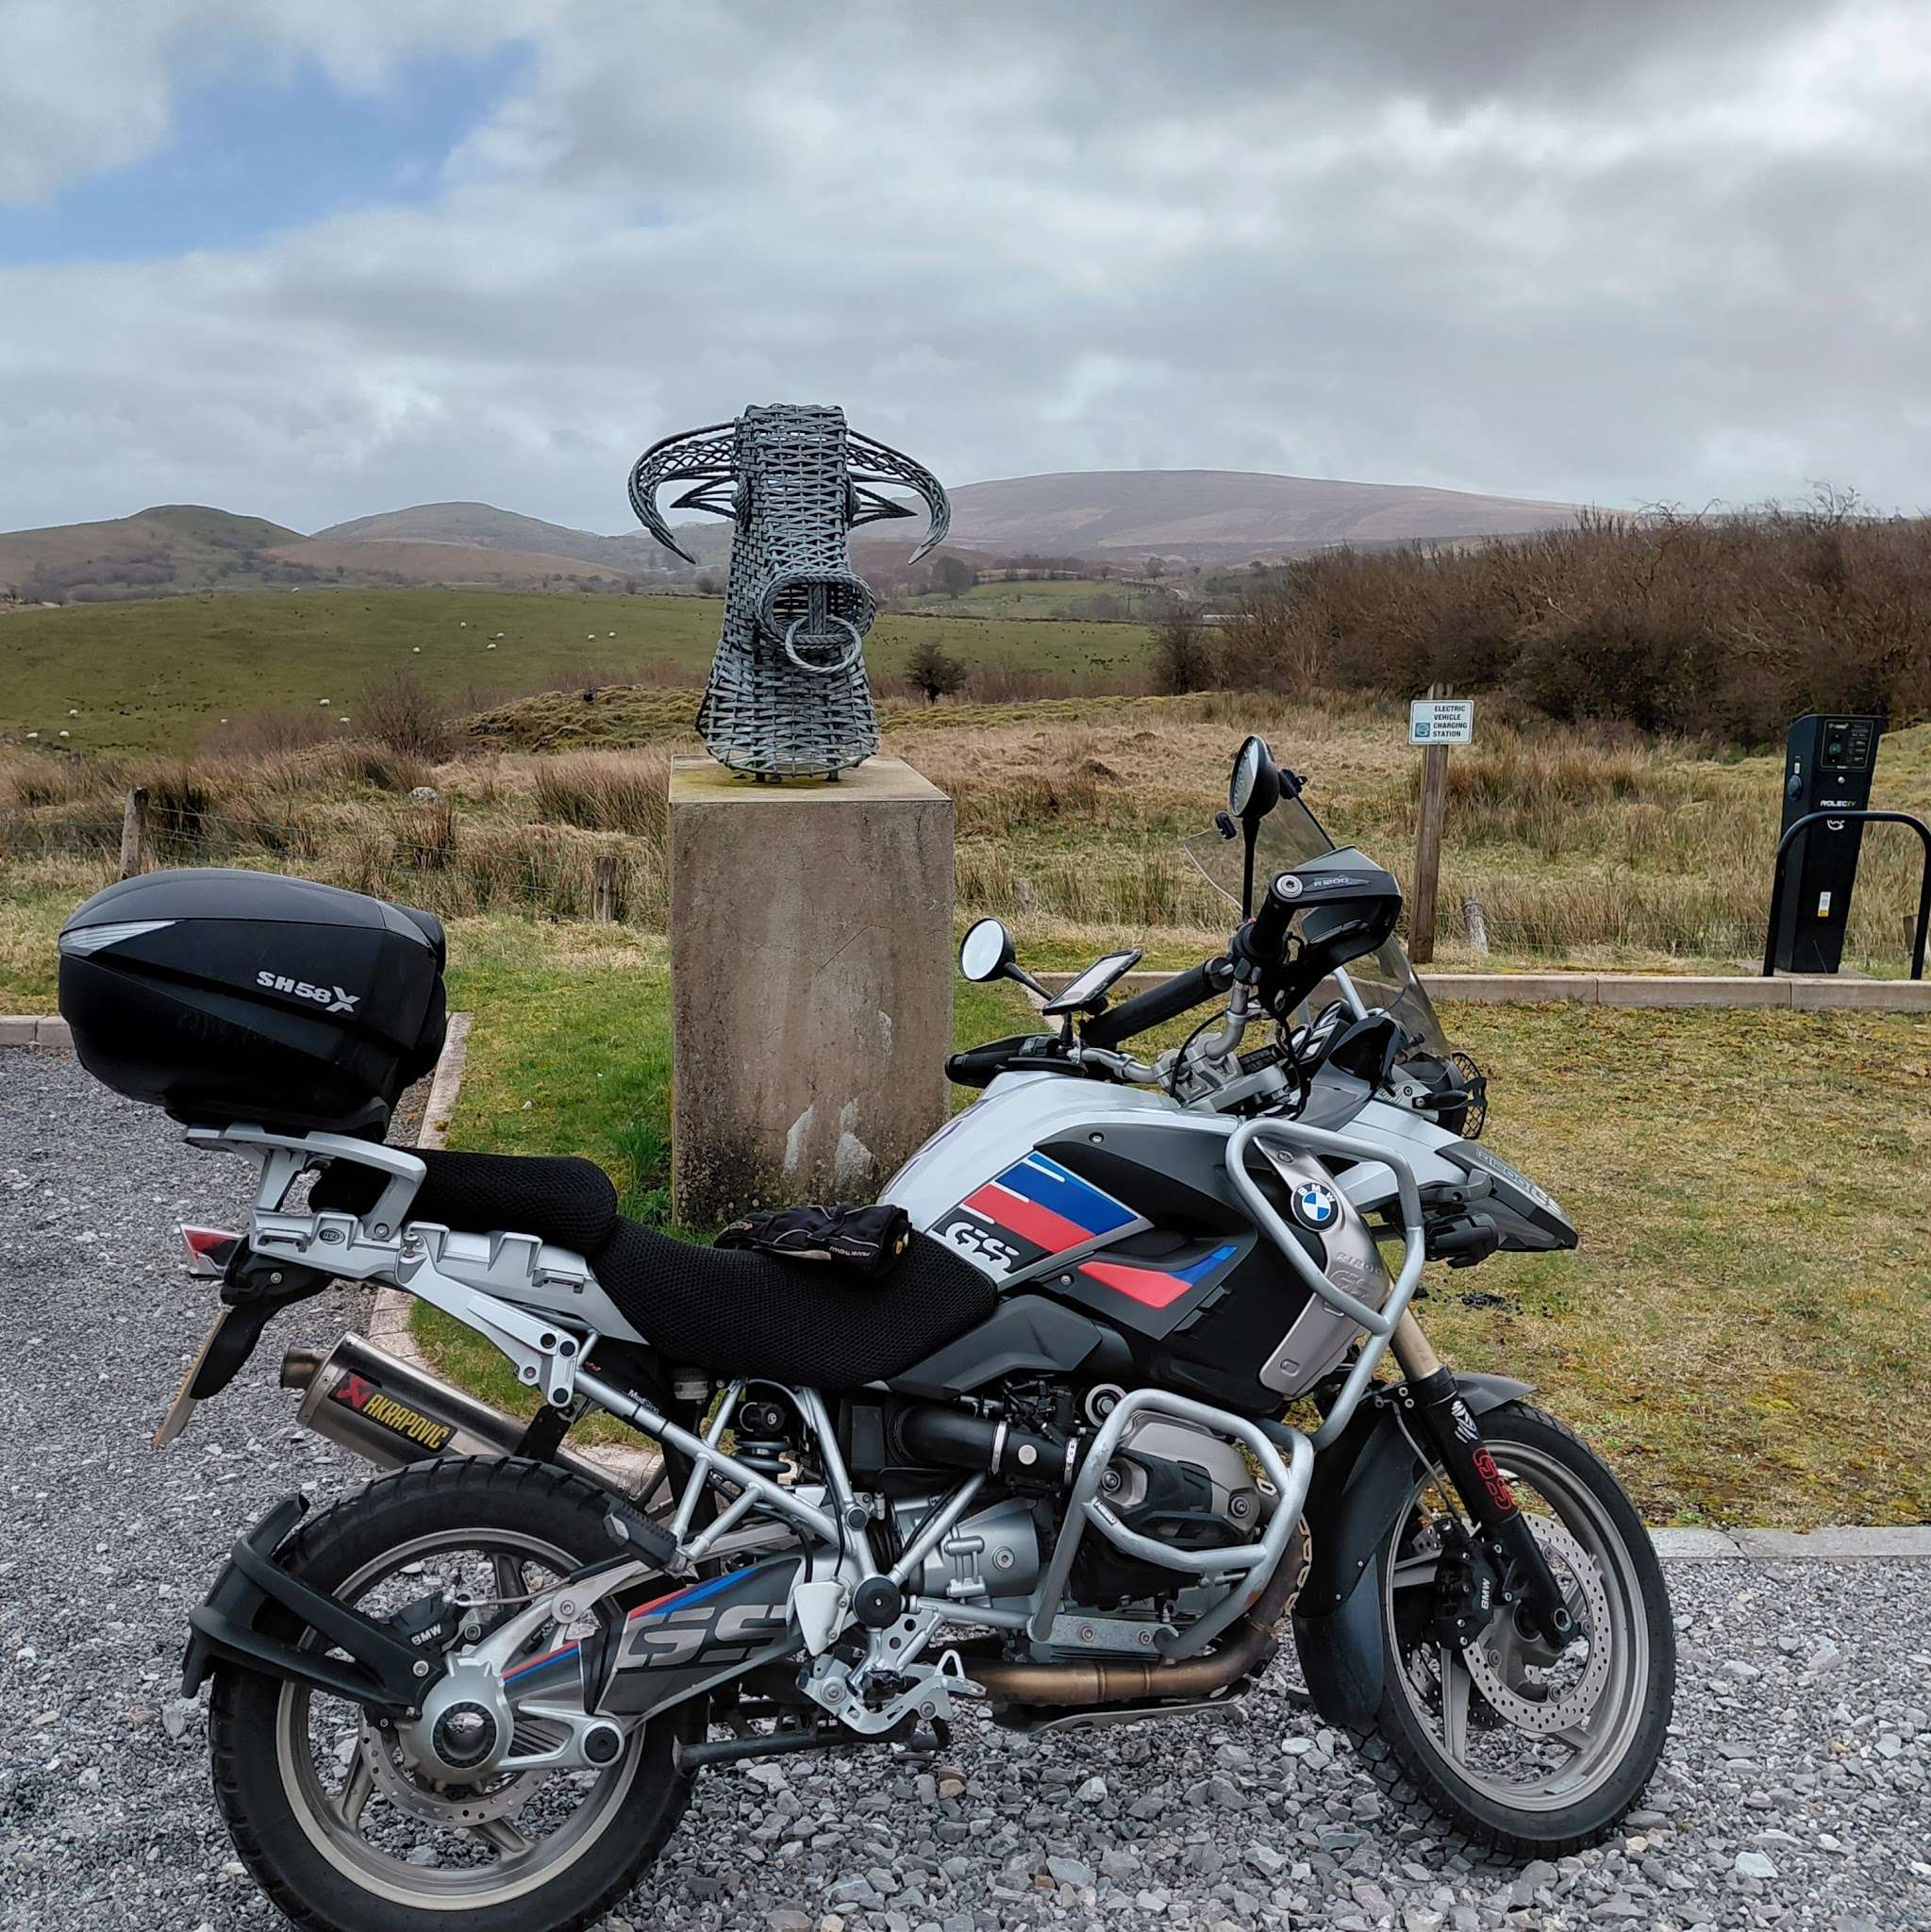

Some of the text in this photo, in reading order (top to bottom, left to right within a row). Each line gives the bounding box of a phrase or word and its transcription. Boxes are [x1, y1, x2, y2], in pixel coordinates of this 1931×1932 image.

[256, 970, 361, 1014] SH58X
[1297, 1184, 1336, 1203] BMW
[1481, 1577, 1490, 1610] BMW
[410, 1624, 442, 1645] BMW
